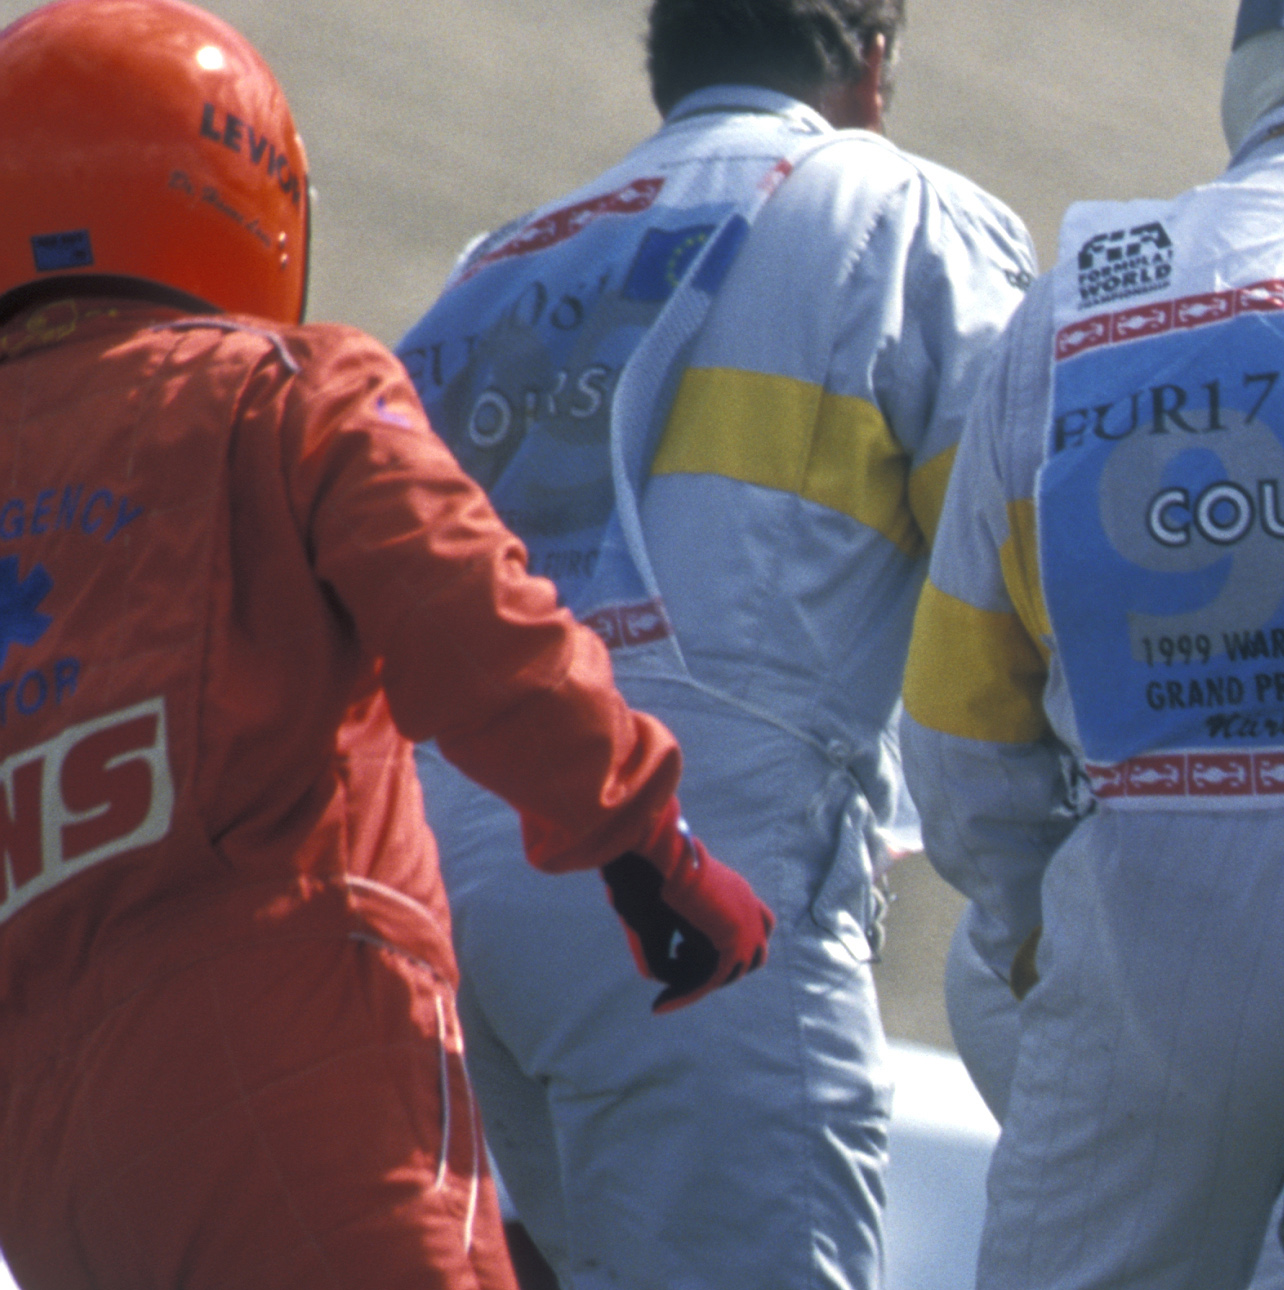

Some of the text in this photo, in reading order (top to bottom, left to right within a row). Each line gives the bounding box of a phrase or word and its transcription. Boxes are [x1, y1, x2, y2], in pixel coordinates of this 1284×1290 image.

[1079, 264, 1172, 299] WORLD
[1142, 634, 1211, 667] 1999
[1145, 675, 1245, 711] GRAND
